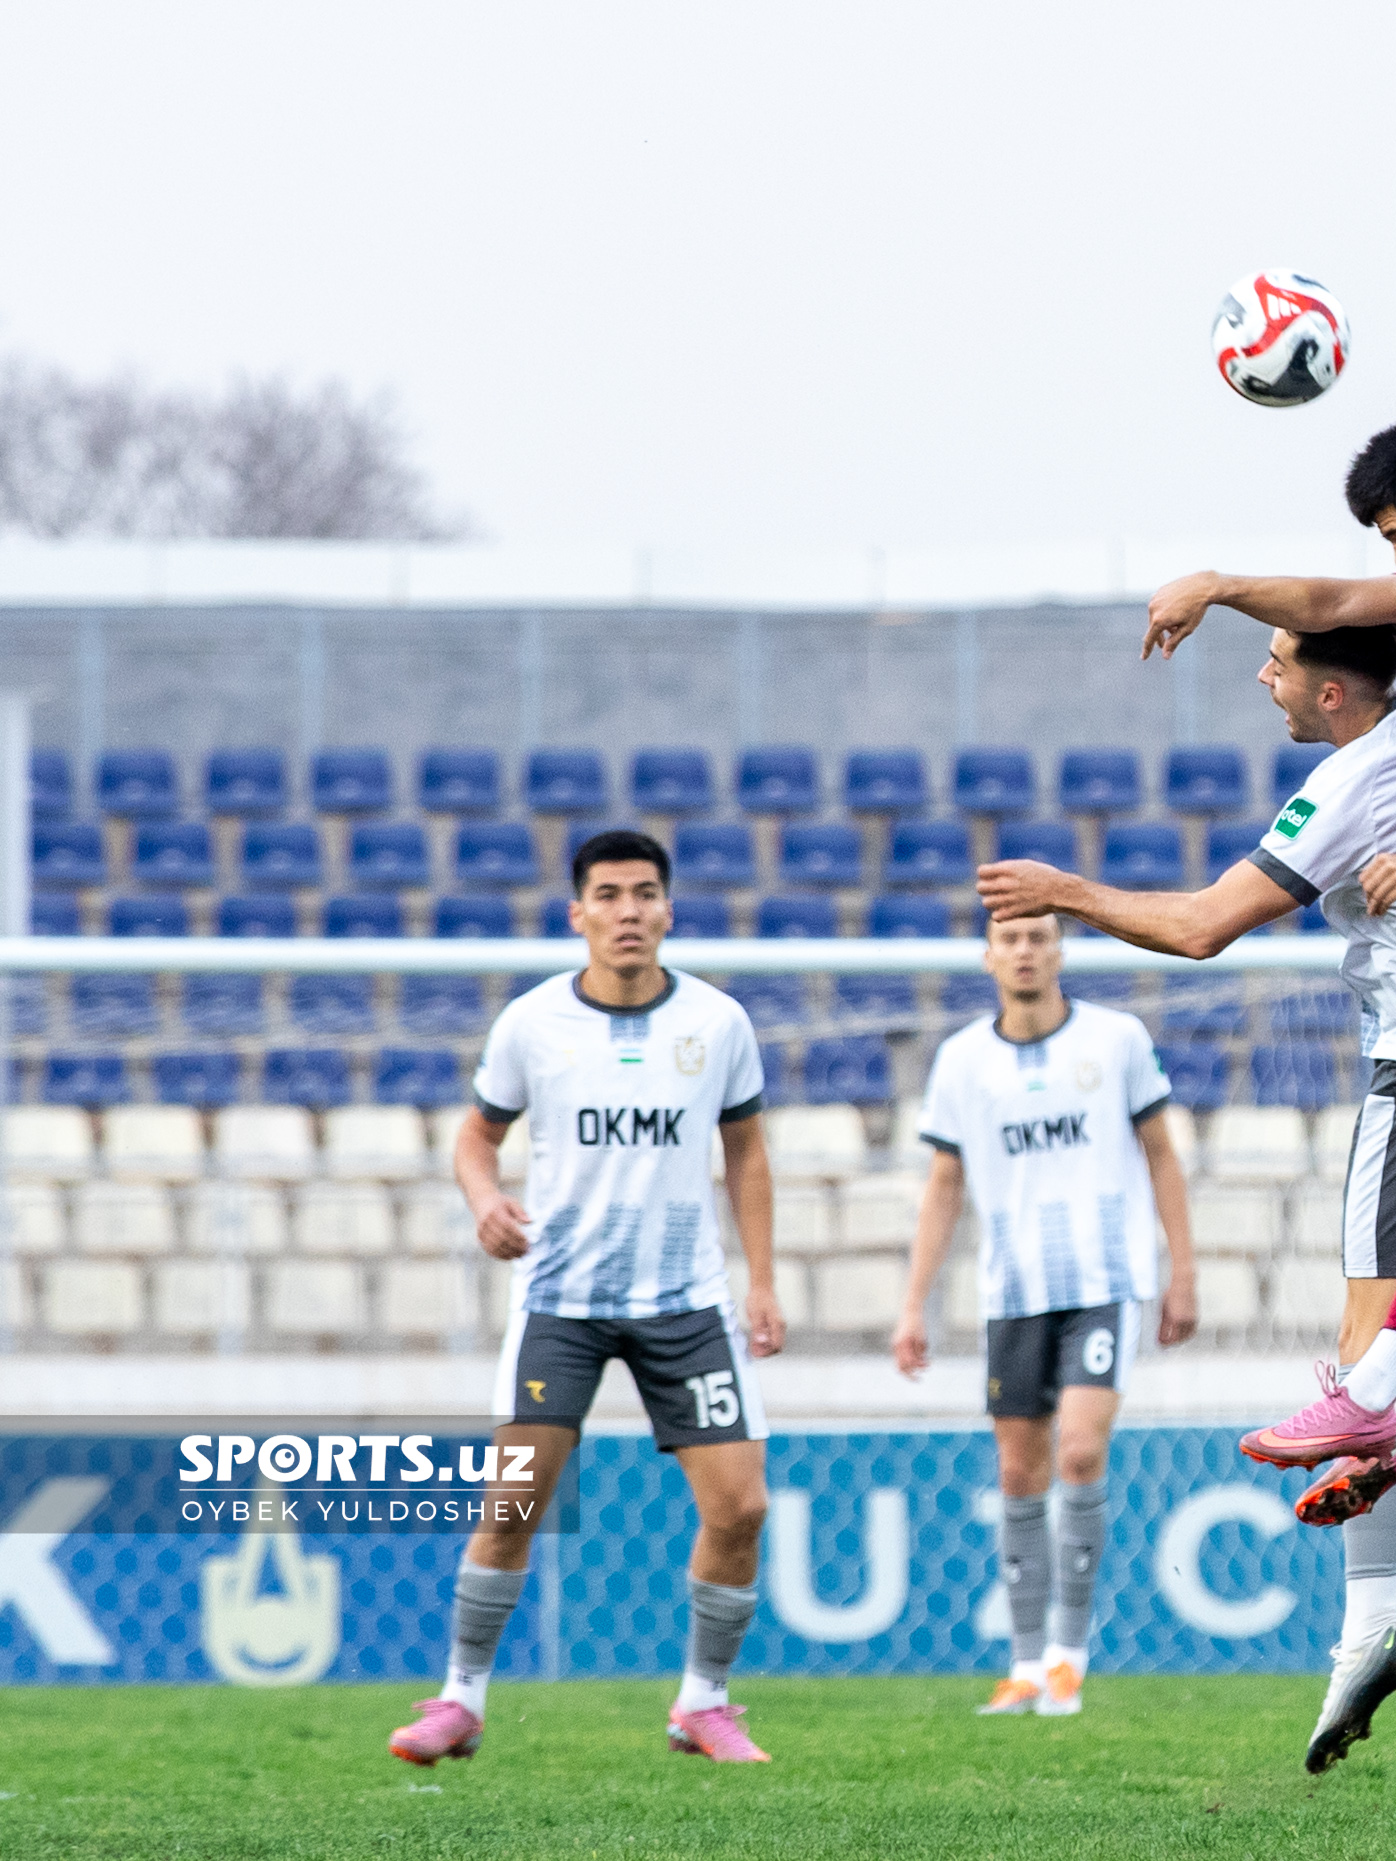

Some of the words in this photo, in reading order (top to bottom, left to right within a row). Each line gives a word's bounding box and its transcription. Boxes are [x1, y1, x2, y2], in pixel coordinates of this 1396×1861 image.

[577, 1107, 686, 1146] OKMK
[1002, 1111, 1091, 1157] OKMK
[1082, 1327, 1115, 1375] 6
[685, 1370, 740, 1429] 15
